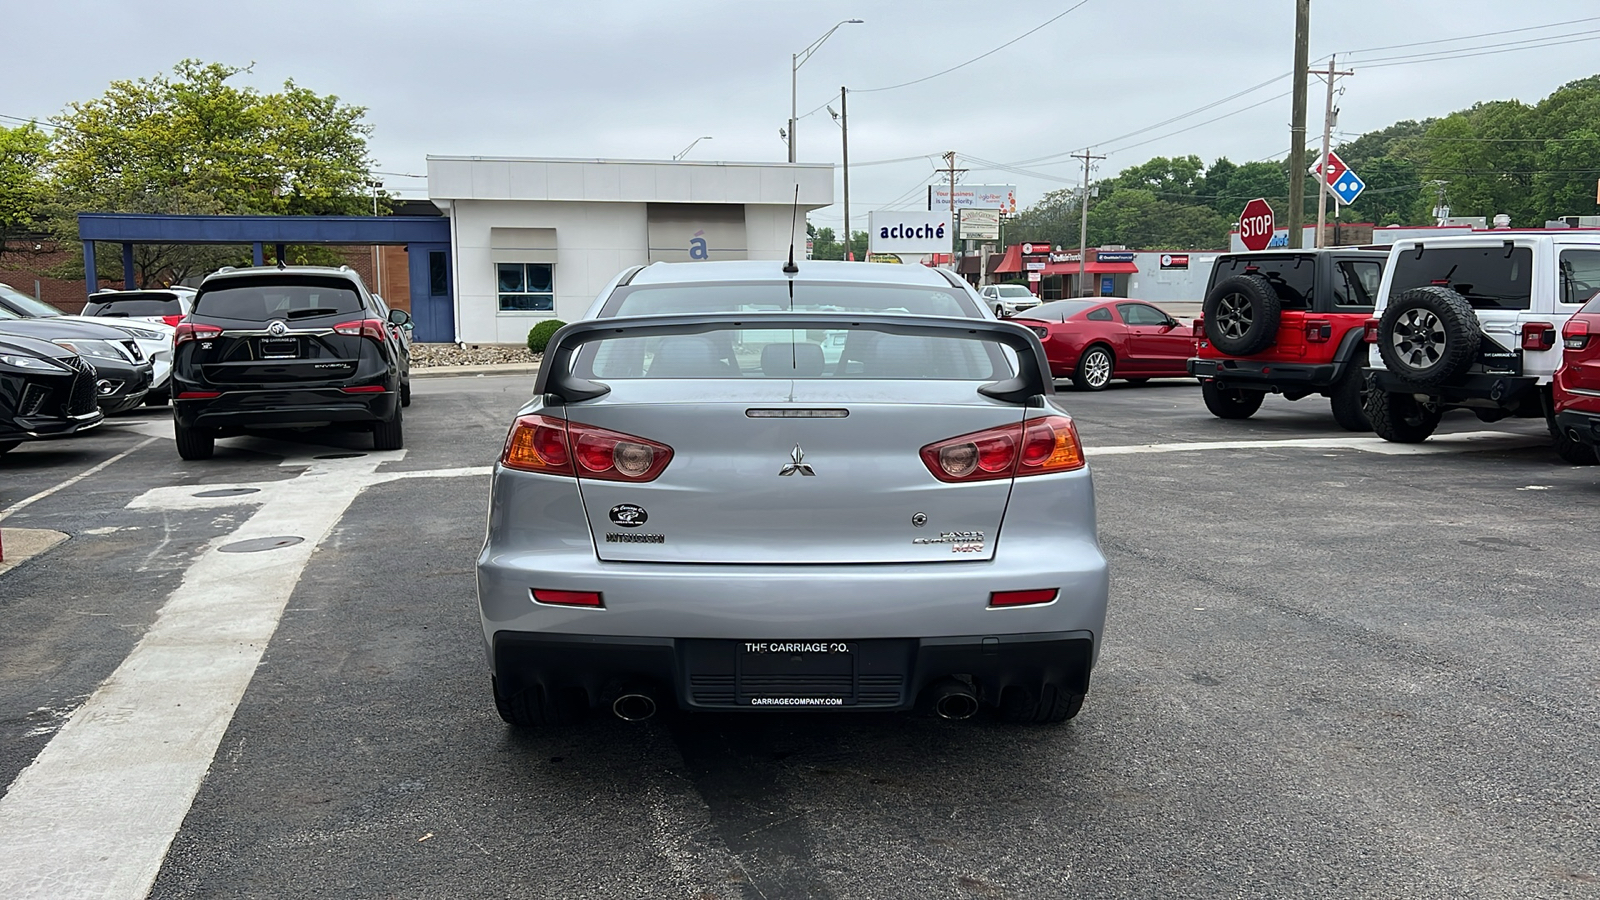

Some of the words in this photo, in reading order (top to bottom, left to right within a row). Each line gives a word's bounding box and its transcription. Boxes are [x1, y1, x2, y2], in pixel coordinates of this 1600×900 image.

[880, 222, 945, 239] acloché
[1242, 215, 1271, 238] STOP
[689, 229, 708, 260] á
[606, 532, 665, 543] MITSUBISHI
[952, 544, 984, 553] MR
[745, 643, 768, 653] THE
[770, 643, 828, 652] CARRIAGE
[830, 643, 849, 652] CO.
